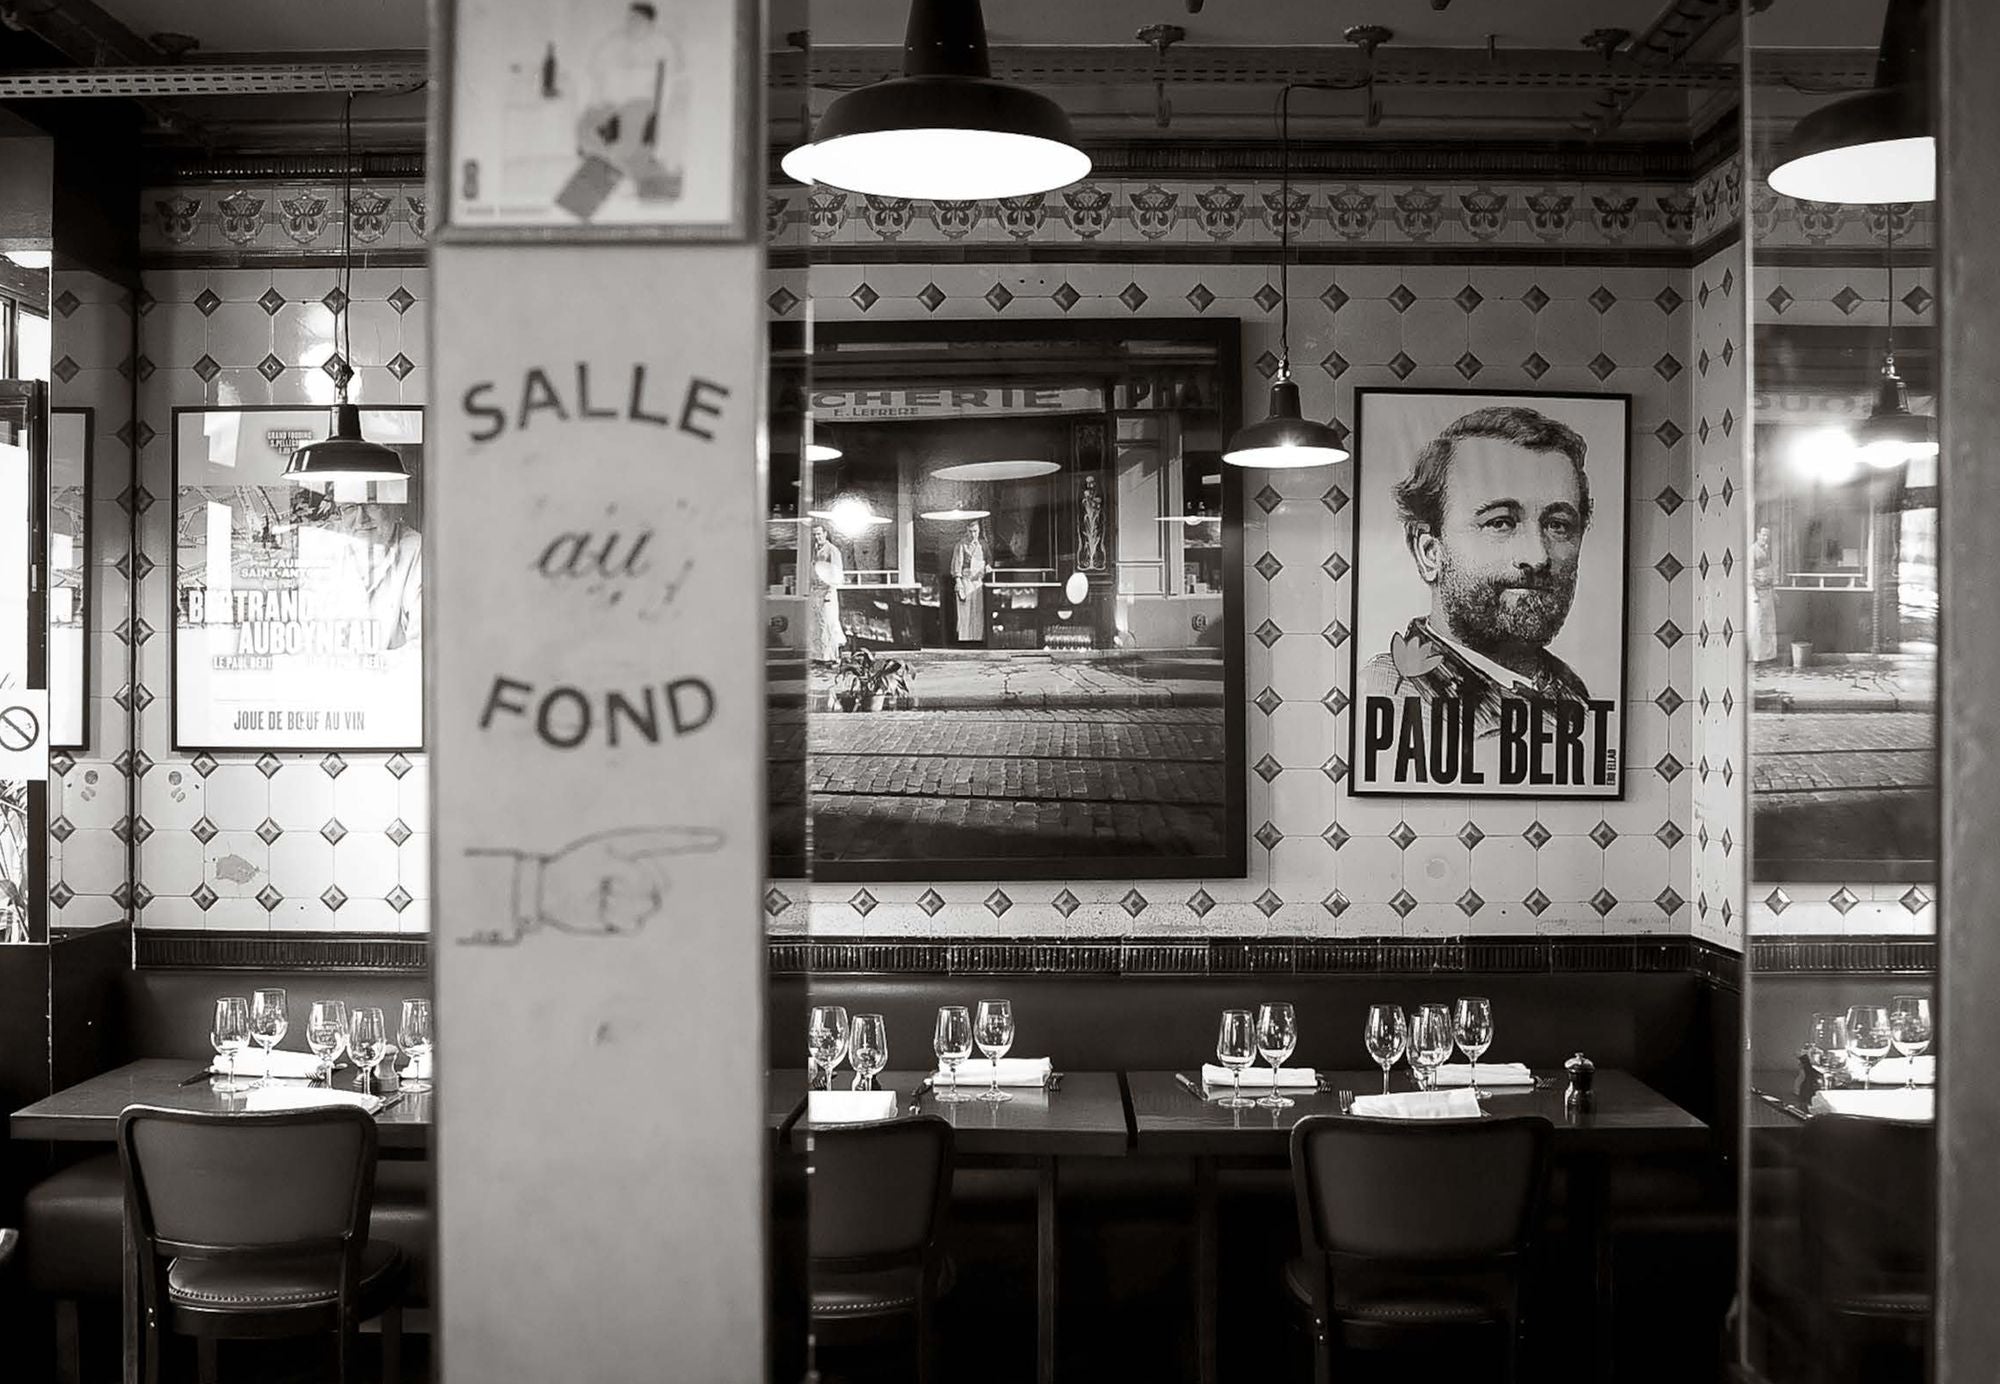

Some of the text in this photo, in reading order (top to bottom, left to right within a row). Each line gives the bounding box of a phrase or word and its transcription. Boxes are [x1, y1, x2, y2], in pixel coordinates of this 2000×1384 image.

[463, 361, 731, 443] SALLE
[811, 388, 1063, 409] CHERIE
[531, 530, 655, 580] au
[189, 590, 315, 622] BRTRAND
[234, 711, 365, 730] JOUE DE BŒUF AU VIN
[479, 675, 717, 749] FOND
[1365, 696, 1615, 785] PAUL BERT
